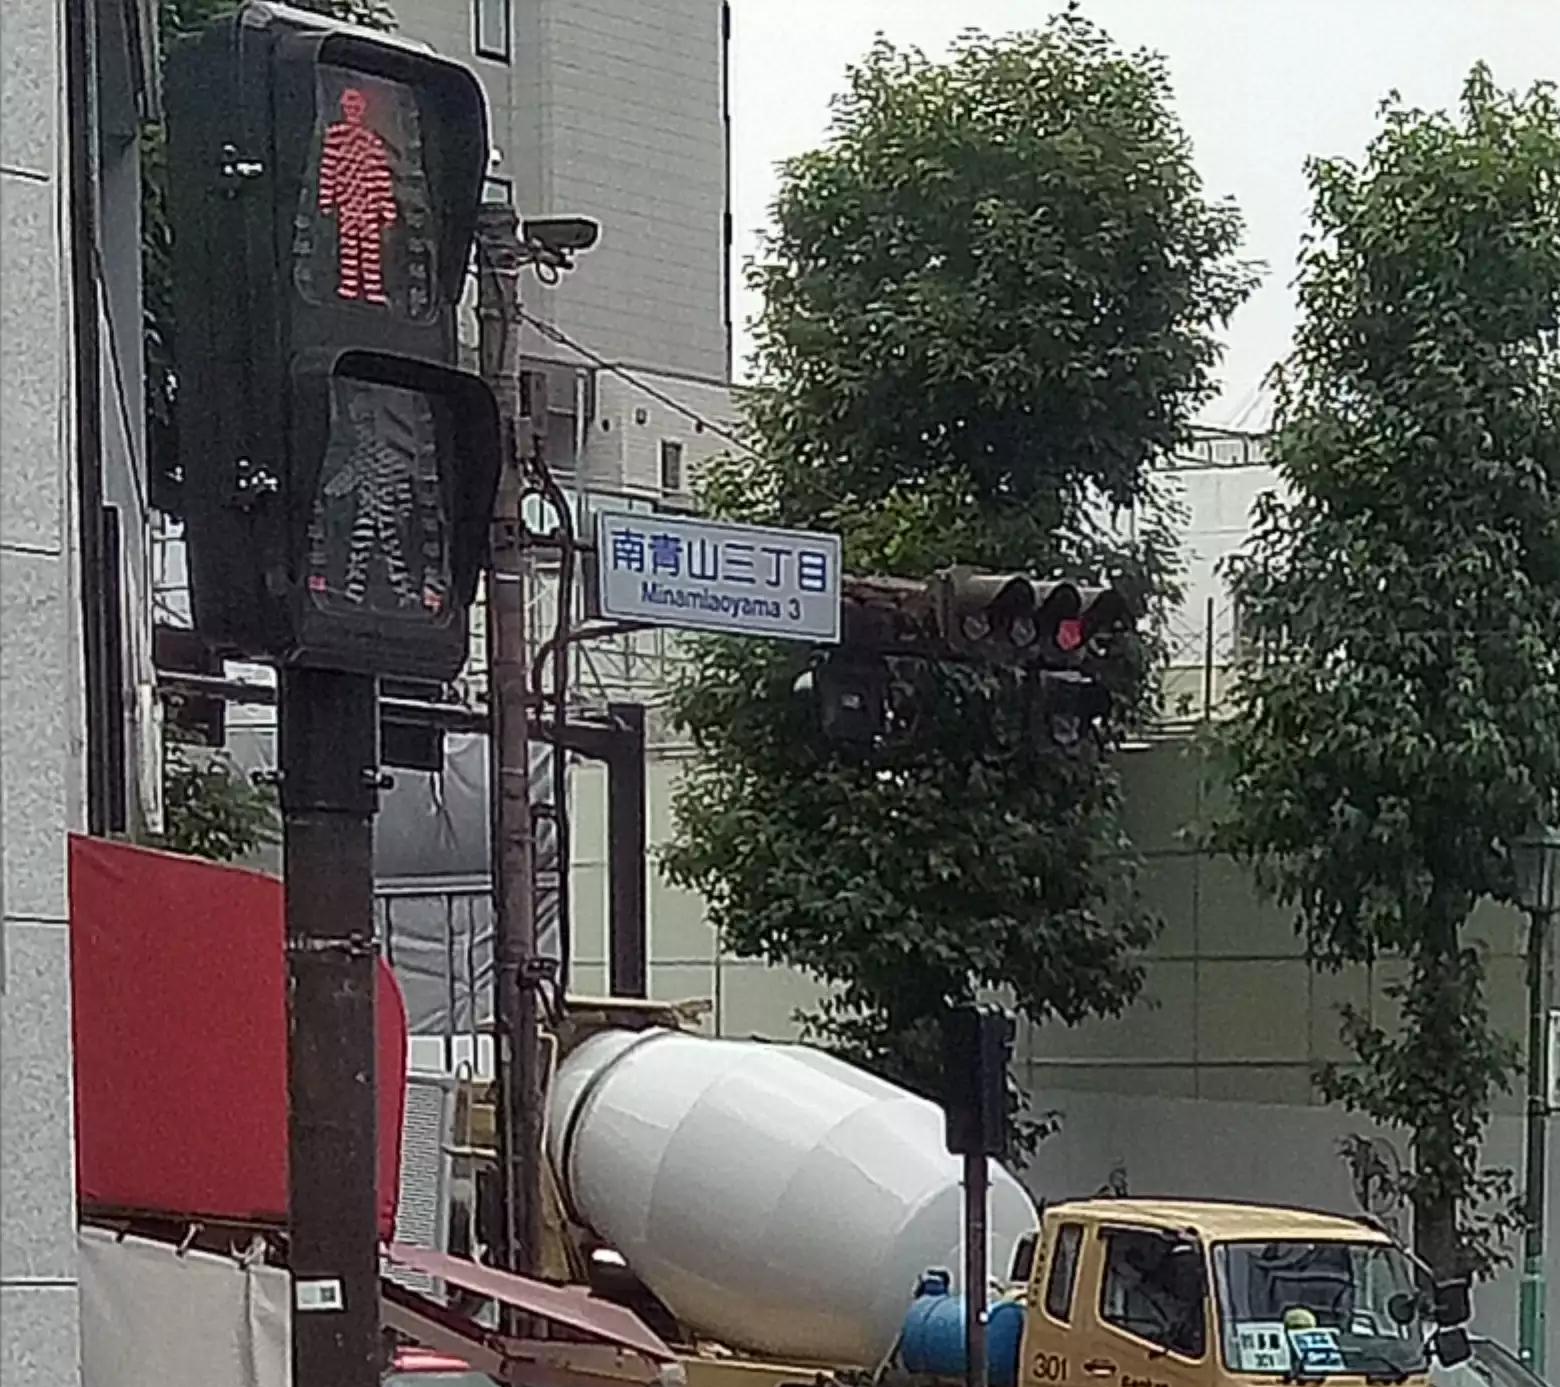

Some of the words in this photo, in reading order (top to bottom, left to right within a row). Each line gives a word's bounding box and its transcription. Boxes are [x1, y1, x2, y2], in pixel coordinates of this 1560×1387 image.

[611, 528, 826, 592] 南青山三丁目
[641, 582, 781, 618] Minamiaoyama
[789, 598, 801, 621] 3
[1032, 1351, 1067, 1381] 301
